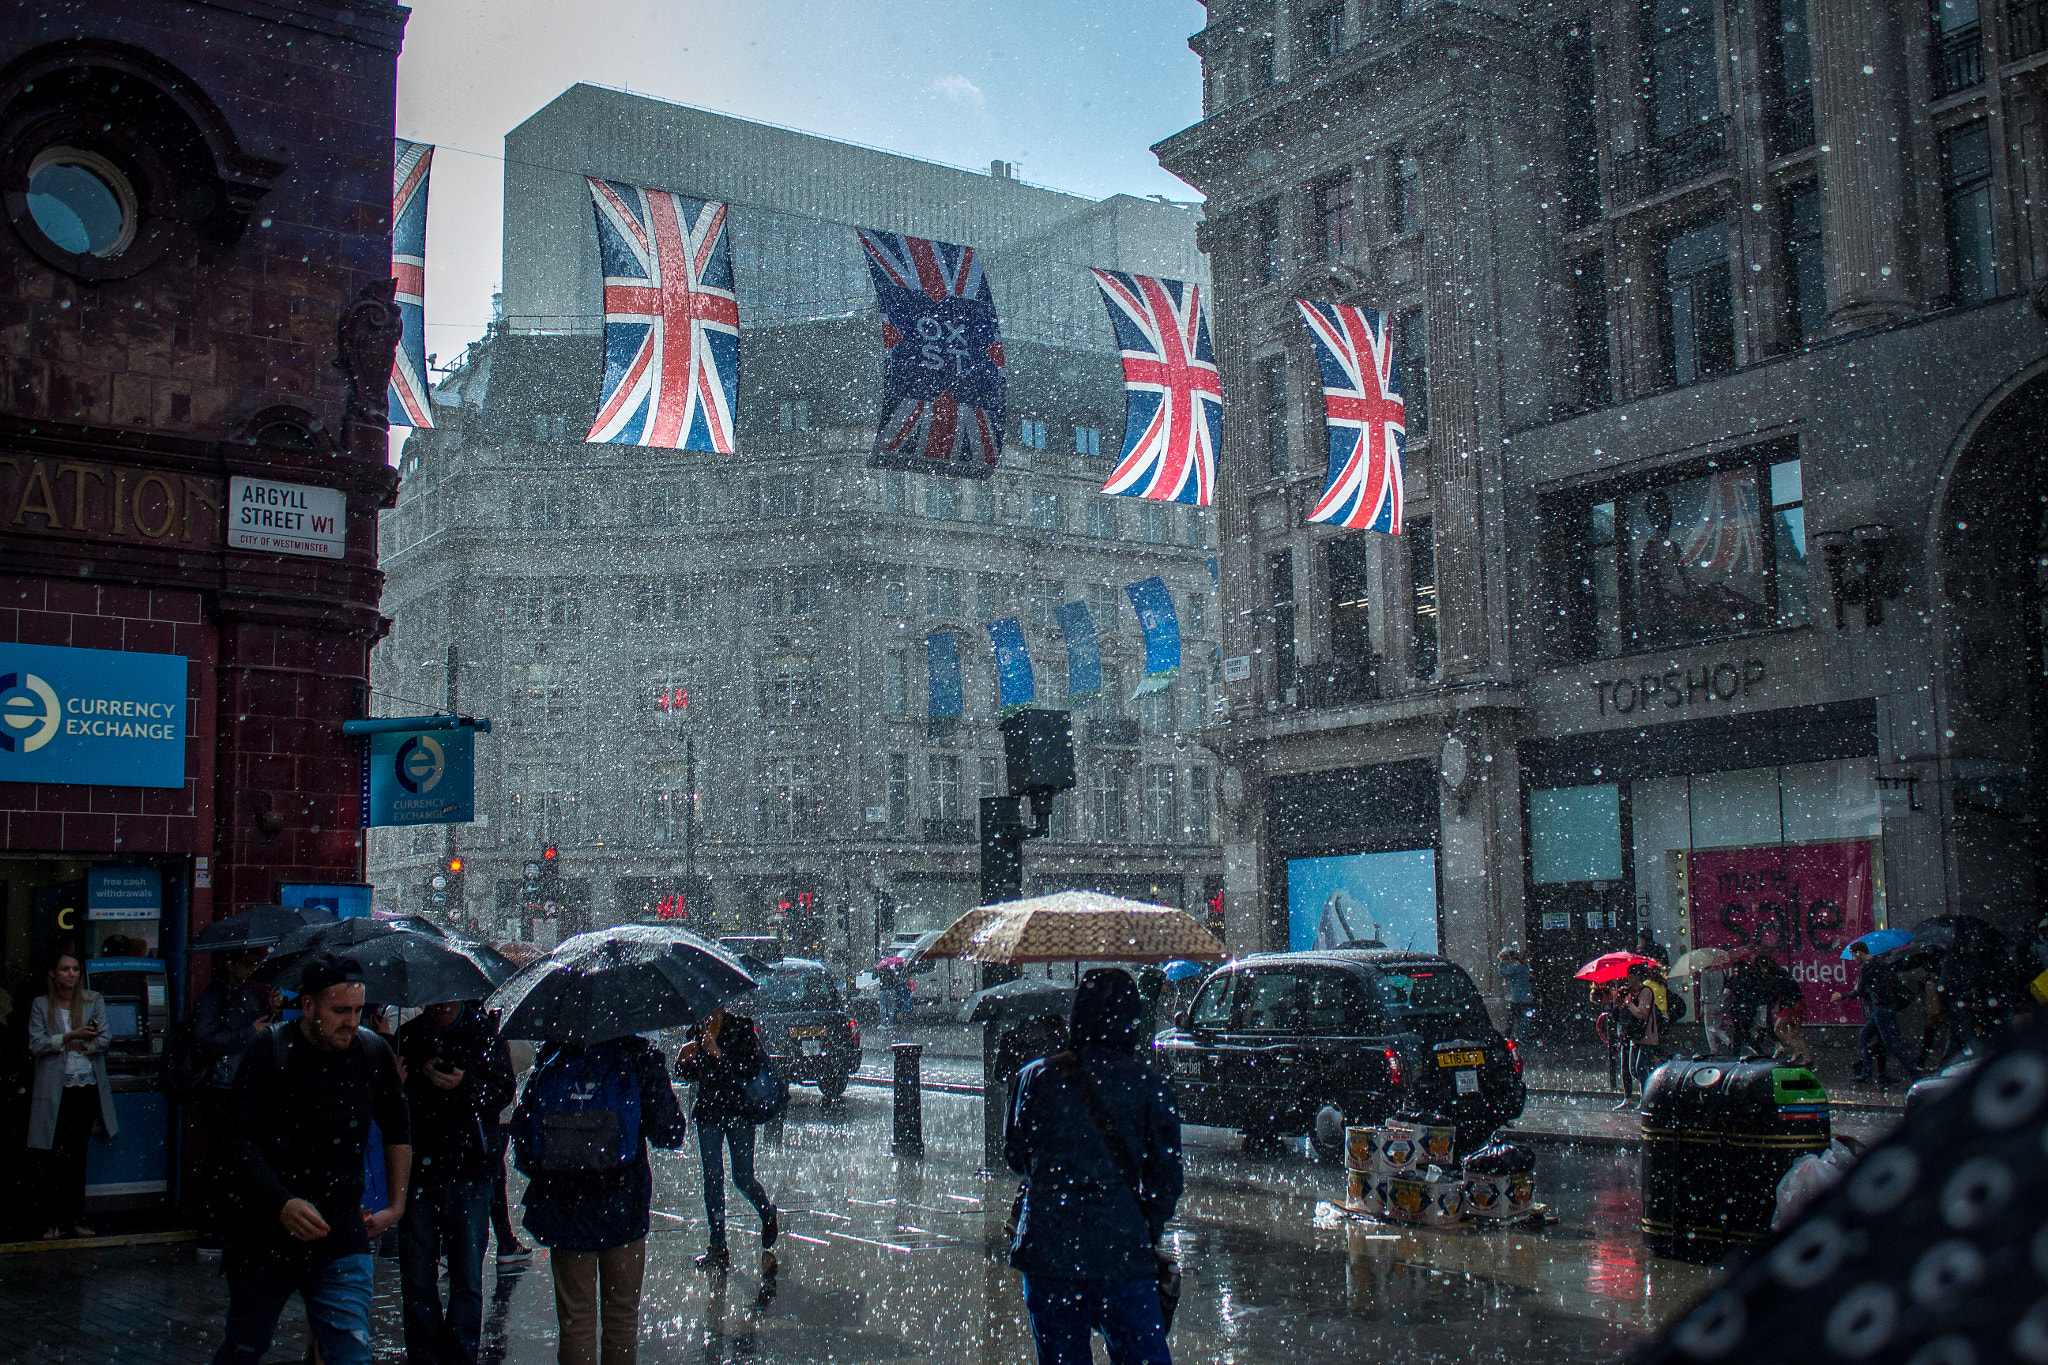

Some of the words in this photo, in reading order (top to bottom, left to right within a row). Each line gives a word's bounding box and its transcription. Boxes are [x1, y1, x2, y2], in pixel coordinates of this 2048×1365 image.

[917, 317, 968, 347] OX
[242, 485, 308, 509] ARGYLL
[241, 507, 304, 530] STREET
[311, 515, 334, 534] W1
[240, 534, 258, 544] CITY
[260, 537, 271, 546] OF
[273, 538, 328, 553] WESTMINSTER
[1589, 658, 1765, 717] TOPSHOP
[66, 698, 176, 719] CURRENCY
[66, 718, 175, 740] EXCHANGE
[393, 798, 446, 810] CURRENCY
[393, 809, 446, 822] EXCHANGE
[103, 877, 122, 886] free
[123, 877, 147, 886] cash
[1718, 870, 1787, 894] more
[95, 889, 153, 898] withdrawals
[1719, 884, 1844, 954] sale
[1173, 1058, 1201, 1075] sherbet
